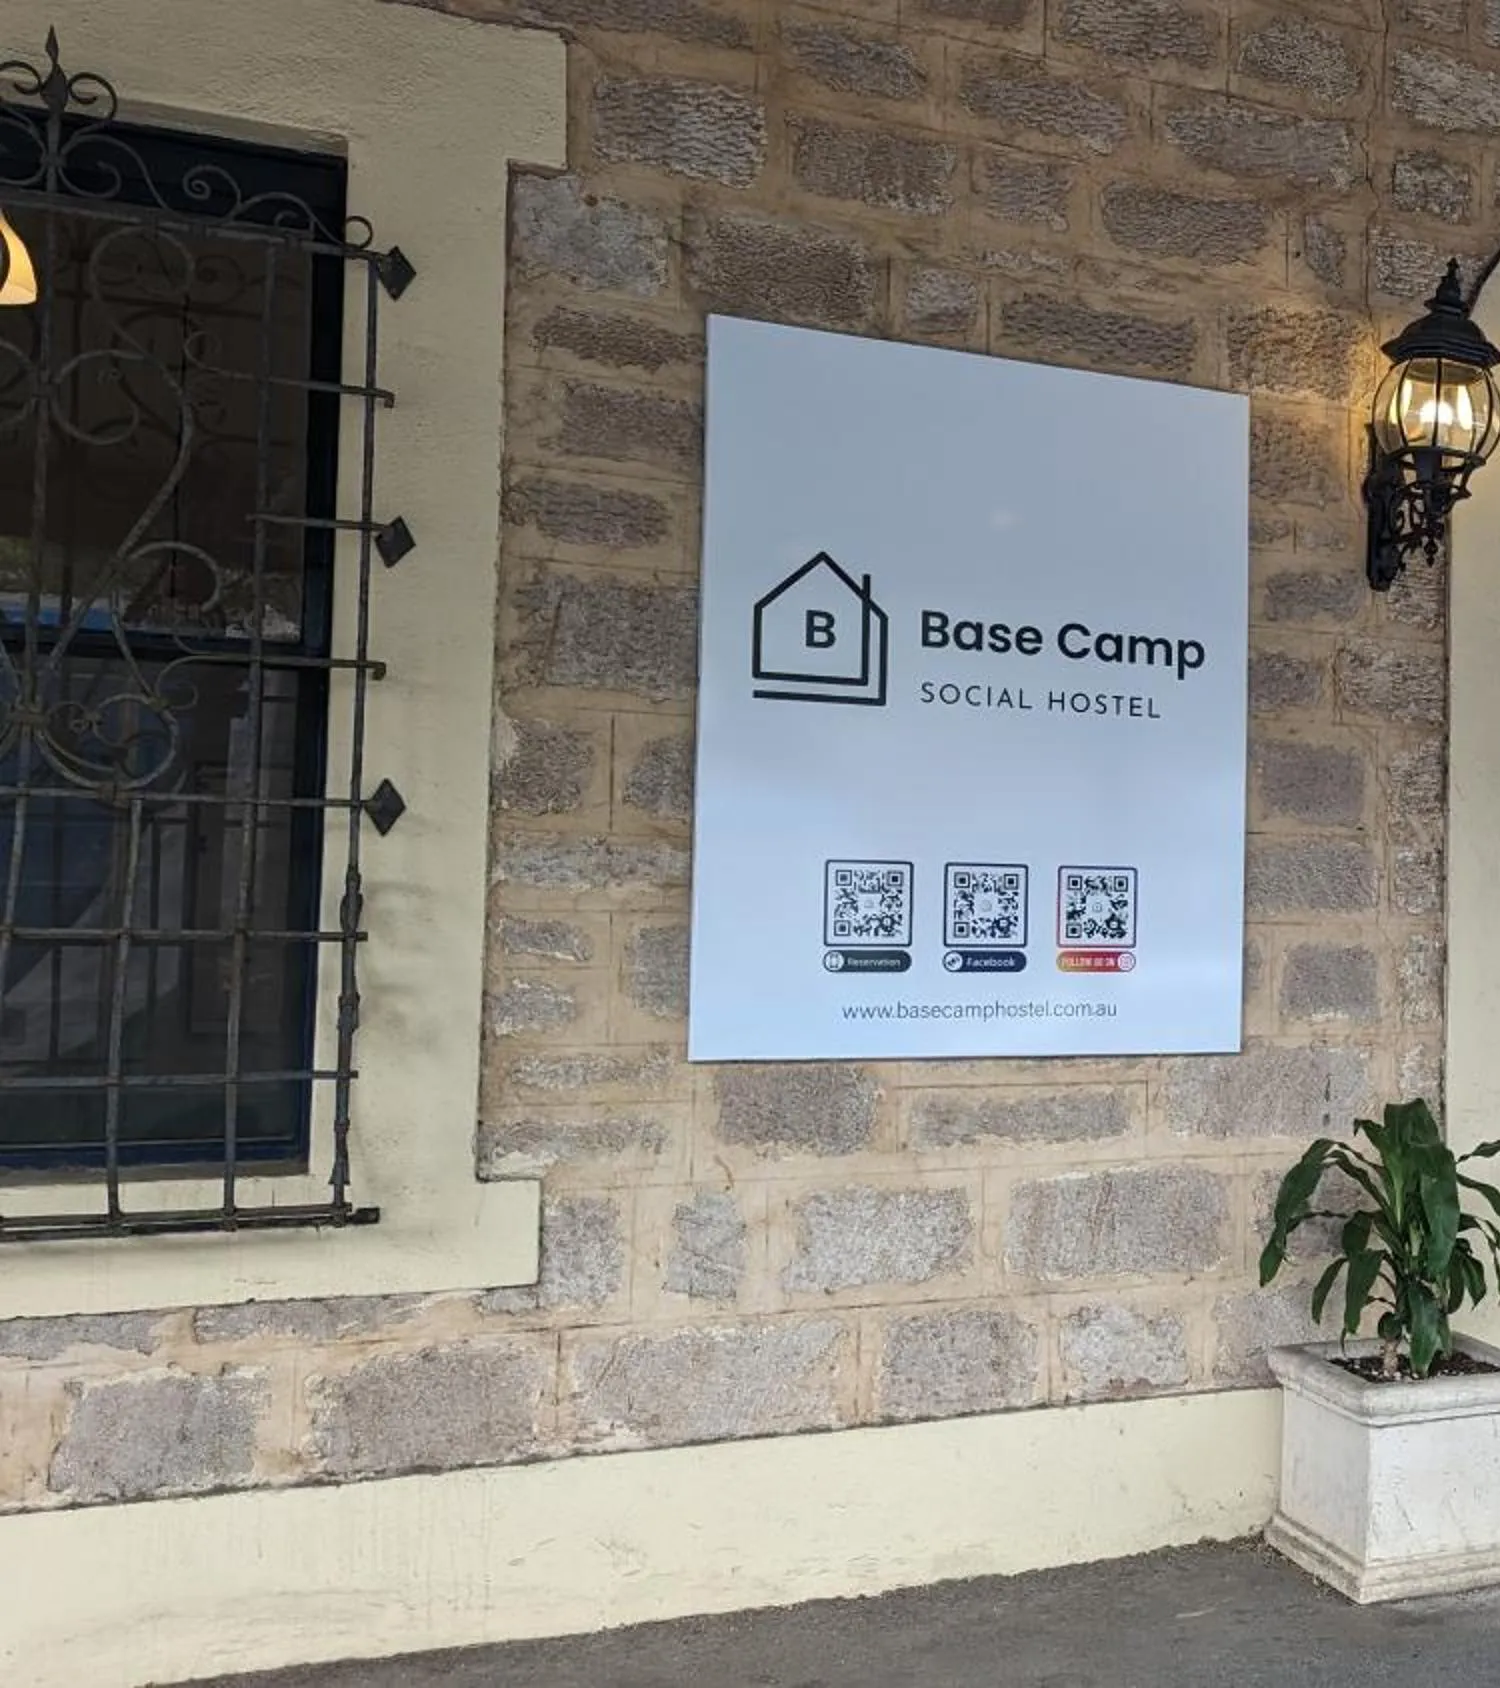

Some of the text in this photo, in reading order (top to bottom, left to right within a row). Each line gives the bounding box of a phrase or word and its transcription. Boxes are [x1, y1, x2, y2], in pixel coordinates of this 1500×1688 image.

[805, 609, 836, 649] B
[921, 609, 1205, 680] Base Camp
[920, 682, 1161, 719] SOCIAL HOSTEL
[966, 957, 1015, 967] Facebook
[842, 1000, 1118, 1022] www.basecamphostel.com.au
